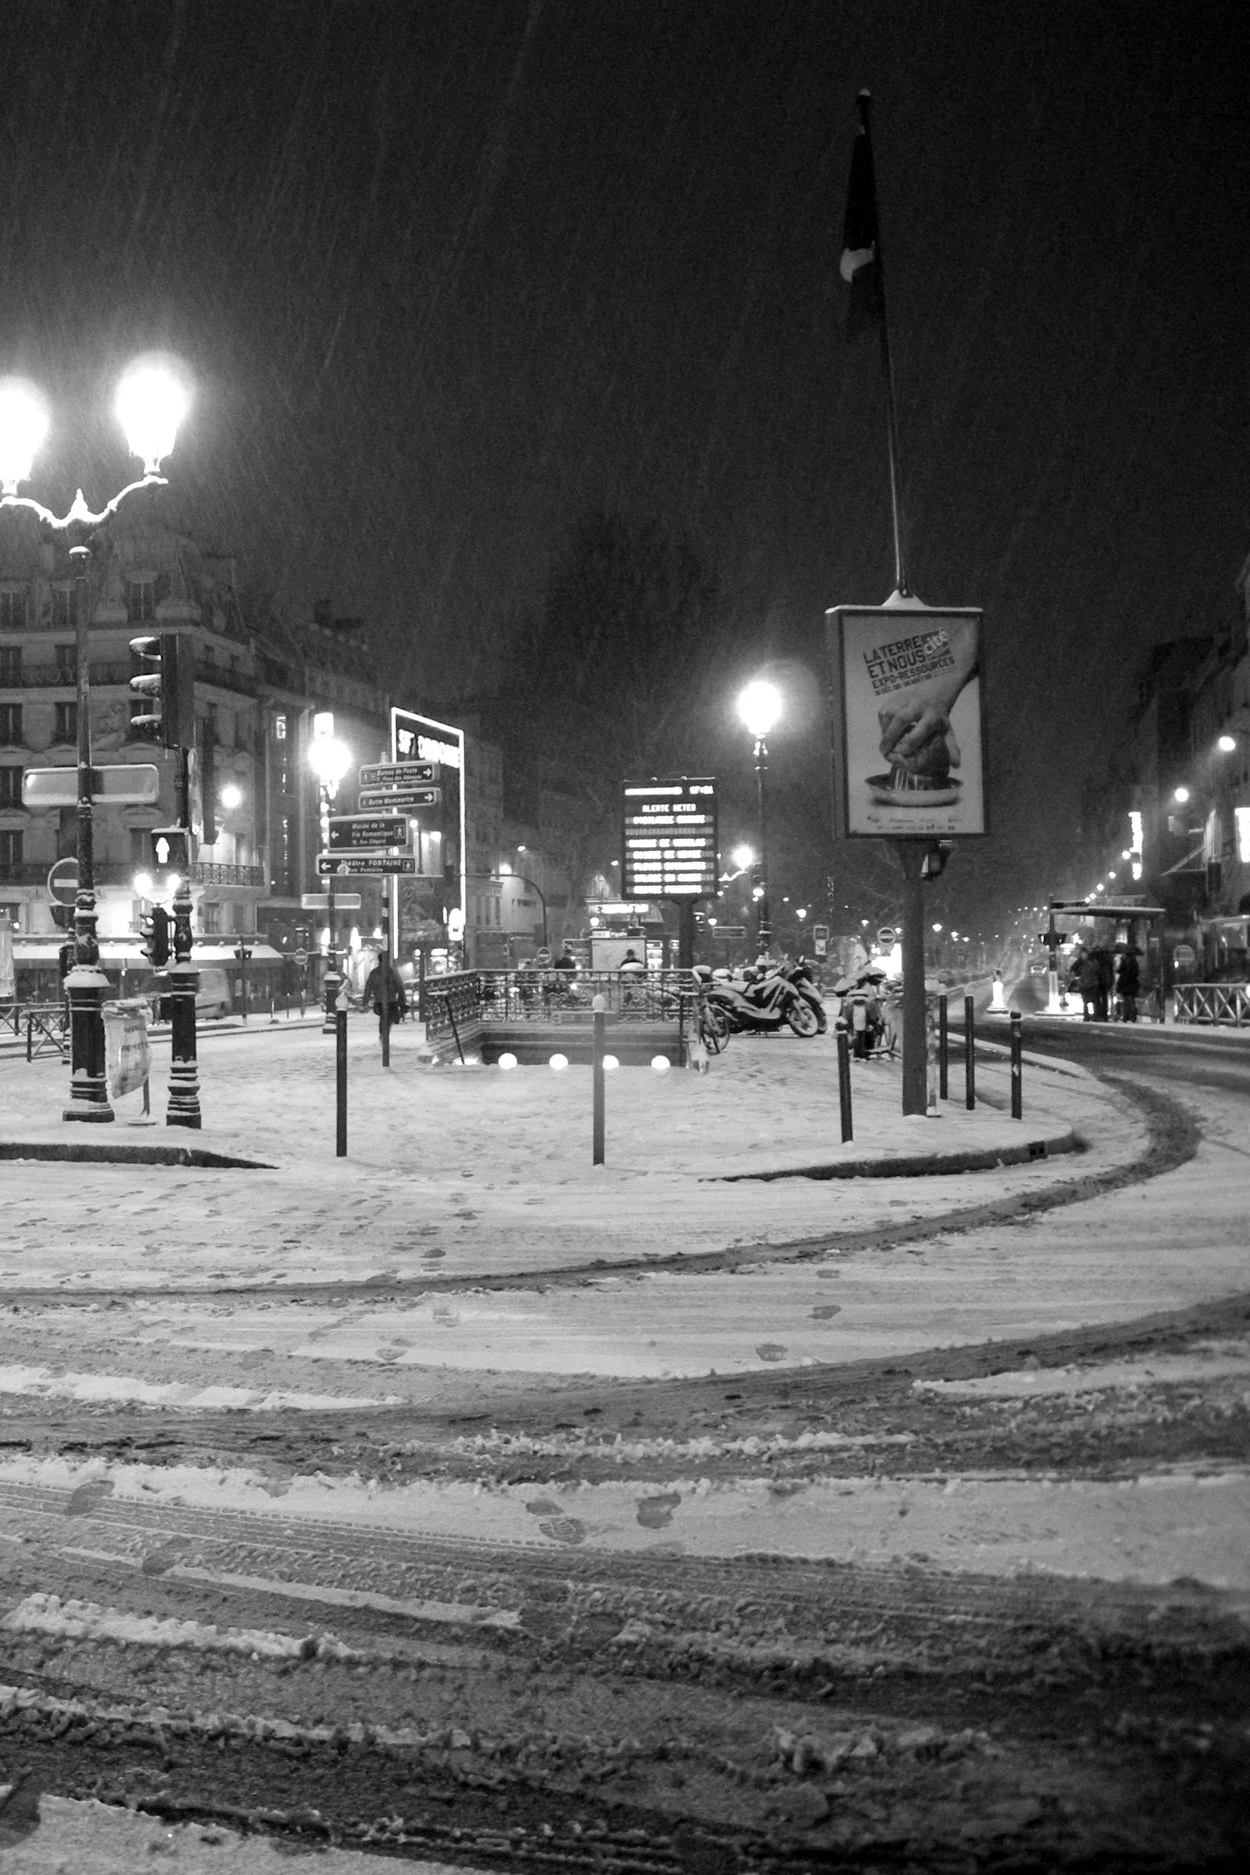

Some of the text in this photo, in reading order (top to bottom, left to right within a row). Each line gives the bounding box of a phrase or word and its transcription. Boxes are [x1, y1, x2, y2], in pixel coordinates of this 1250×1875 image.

[862, 635, 923, 664] LA TERRE
[867, 648, 927, 679] ET NOUS
[642, 804, 670, 812] ALERTE
